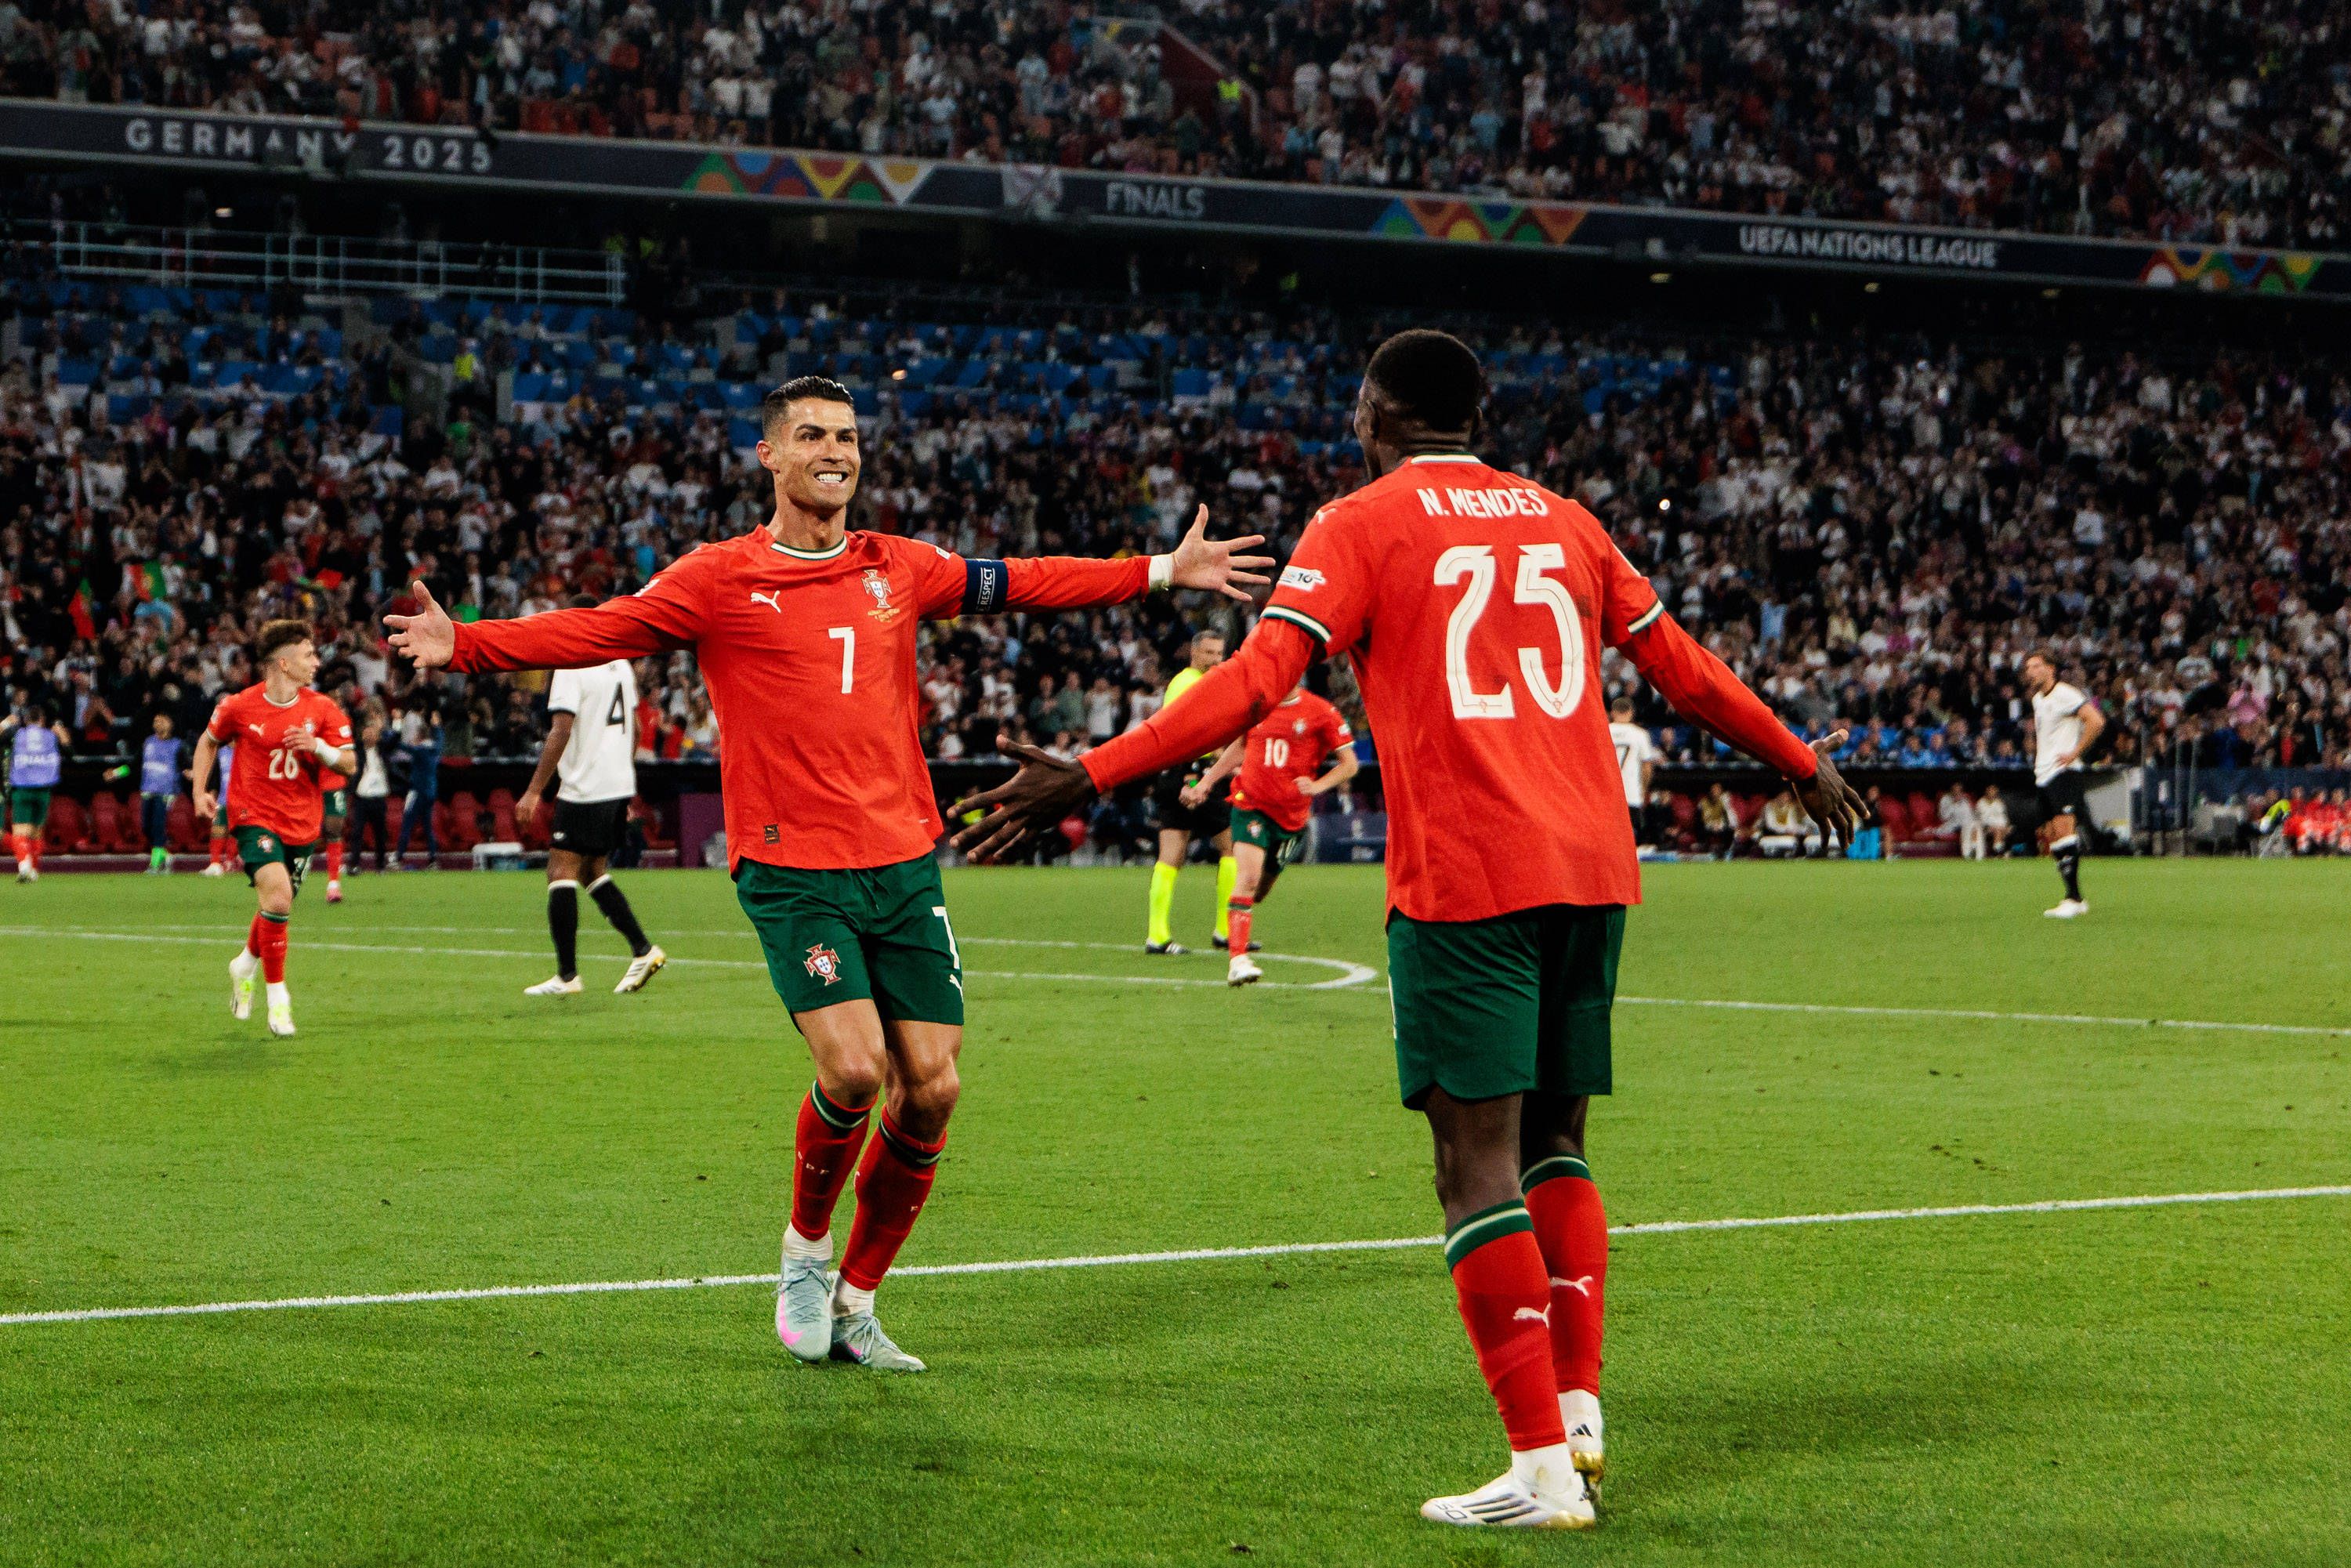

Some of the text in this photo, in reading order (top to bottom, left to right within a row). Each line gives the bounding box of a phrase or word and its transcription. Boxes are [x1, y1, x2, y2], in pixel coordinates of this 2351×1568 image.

[1106, 181, 1205, 218] FINALS
[1739, 224, 1995, 267] UEFA NATIONS LEAGUE
[1416, 487, 1549, 518] N. MENDES
[980, 567, 993, 605] RESPECT
[1433, 543, 1585, 719] 25
[828, 626, 856, 694] 7
[606, 681, 625, 734] 4
[269, 748, 299, 780] 26
[1263, 737, 1290, 769] 10
[931, 906, 960, 969] 7
